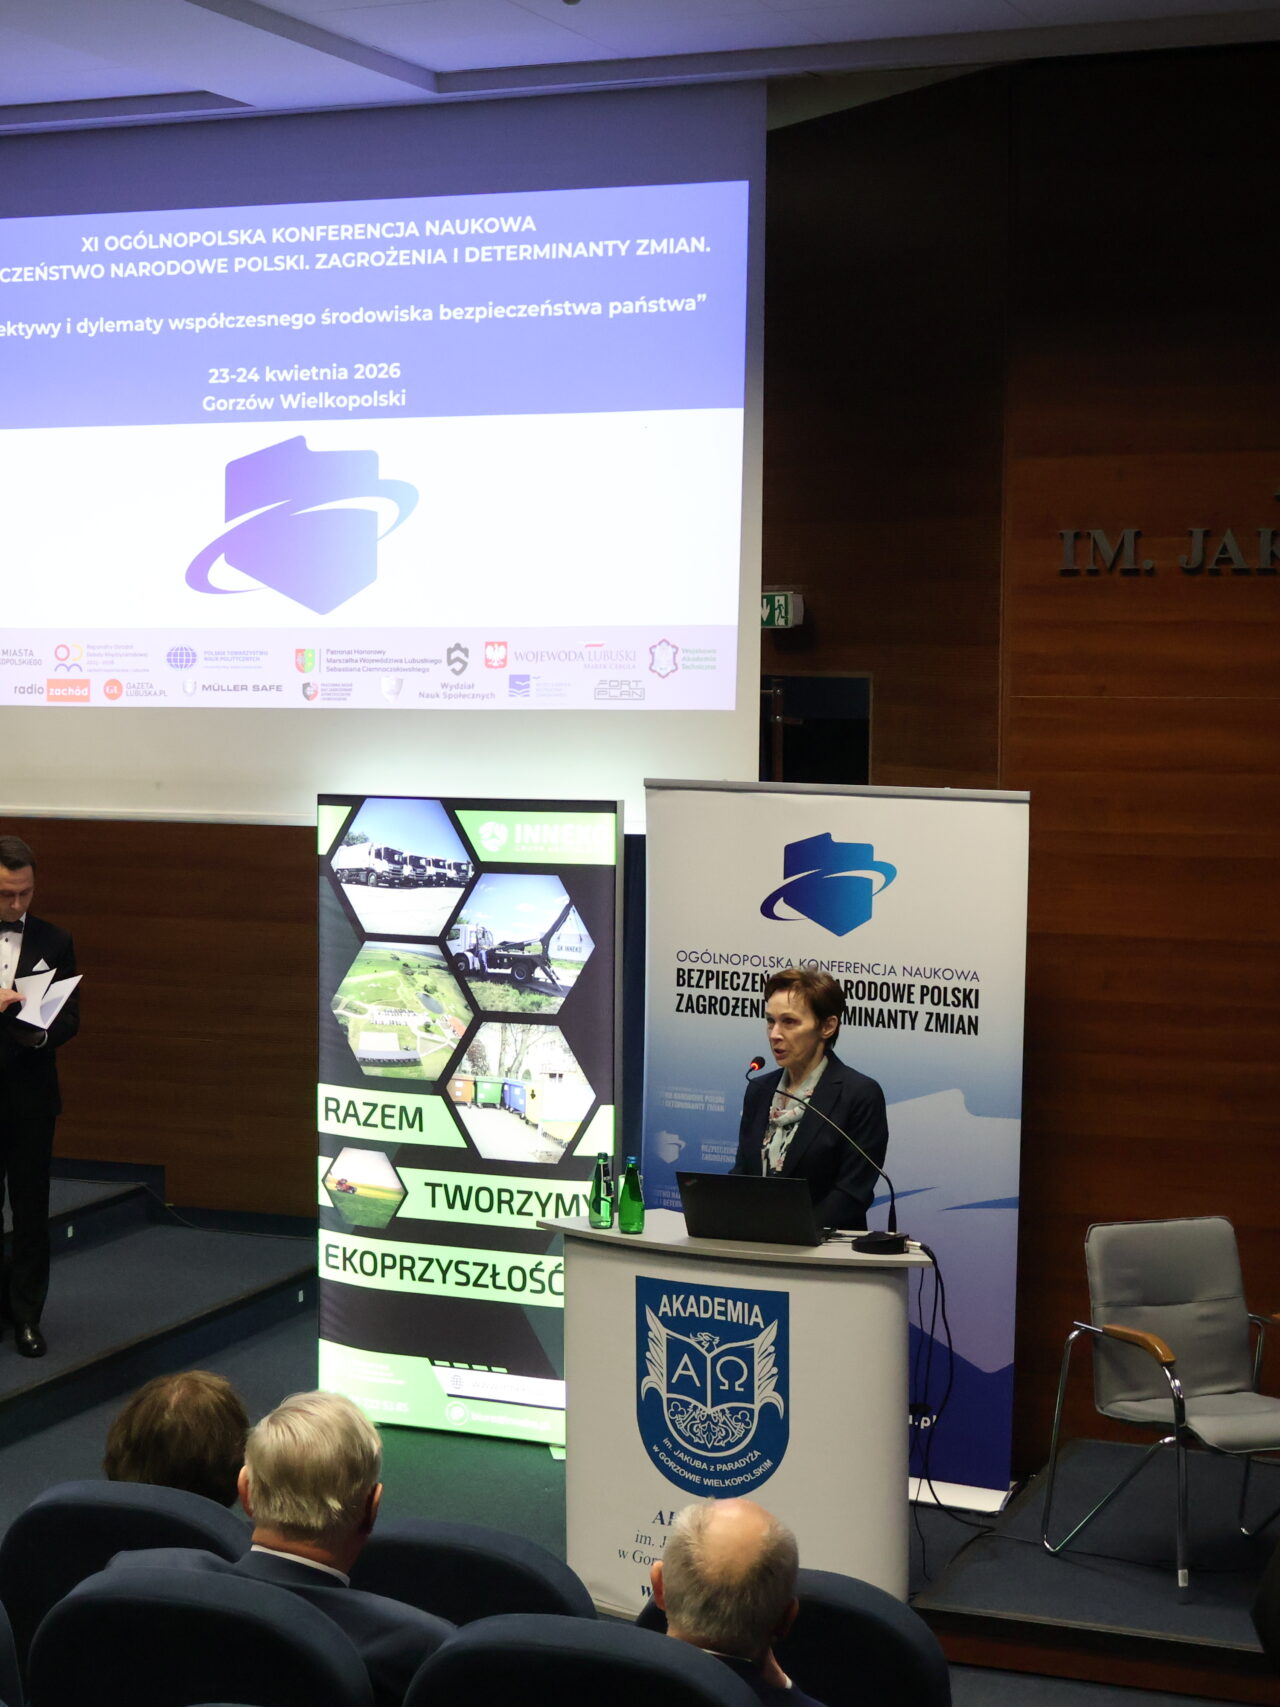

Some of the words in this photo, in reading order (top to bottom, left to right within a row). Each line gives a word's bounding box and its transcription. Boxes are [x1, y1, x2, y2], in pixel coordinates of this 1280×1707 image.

[81, 236, 99, 252] XI
[104, 228, 266, 251] OGÓLNOPOLSKA
[271, 221, 419, 244] KONFERENCJA
[424, 216, 537, 237] NAUKOWA
[110, 258, 228, 279] NARODOWE
[234, 254, 310, 272] POLSKI.
[315, 246, 448, 270] ZAGROŻENIA
[453, 247, 459, 263] I
[464, 239, 631, 263] DETERMINANTY
[635, 236, 711, 256] ZMIAN.
[66, 318, 71, 334] i
[76, 316, 164, 336] dylematy
[168, 311, 317, 335] współczesnego
[320, 305, 434, 326] środowiska
[439, 300, 603, 323] bezpieczeństwa
[208, 367, 260, 384] 23-24
[265, 363, 349, 382] kwietnia
[354, 363, 402, 380] 2026
[202, 394, 275, 411] Gorzów
[279, 389, 407, 411] Wielkopolski
[1059, 528, 1154, 570] IM.
[1, 648, 35, 657] MIASTA
[514, 650, 585, 663] WOJEWODA
[587, 650, 637, 662] LUBUSKI
[14, 684, 45, 695] radio
[49, 686, 89, 697] zachód
[126, 682, 155, 690] GAZETA
[201, 683, 248, 692] MÜLLER
[252, 684, 284, 692] SAFE
[440, 682, 475, 691] Wydział
[597, 680, 643, 688] FORT
[597, 689, 643, 698] PLAN
[442, 691, 496, 701] Społecznych
[676, 949, 794, 969] OGÓLNOPOLSKA
[798, 957, 898, 977] KONFERENCJA
[902, 965, 981, 982] NAUKOWA
[676, 967, 770, 994] BEZPIECZEŃ
[919, 982, 980, 1010] POLSKI
[675, 992, 767, 1019] ZAGROŻENI
[841, 1005, 919, 1032] MINANTY
[924, 1010, 980, 1037] ZMIAN
[324, 1096, 424, 1133] RAZEM
[325, 1243, 564, 1296] EKOPRZYSZŁOŚĆ
[658, 1294, 765, 1329] AKADEMIA
[662, 1437, 673, 1451] im.
[673, 1449, 708, 1471] JAKUBA
[716, 1449, 762, 1472] PARADYŻA
[652, 1444, 660, 1453] w
[658, 1451, 702, 1484] GORZOWIE
[703, 1458, 774, 1488] WIELKOPOLSKIM
[634, 1529, 655, 1547] im.
[618, 1548, 629, 1560] w
